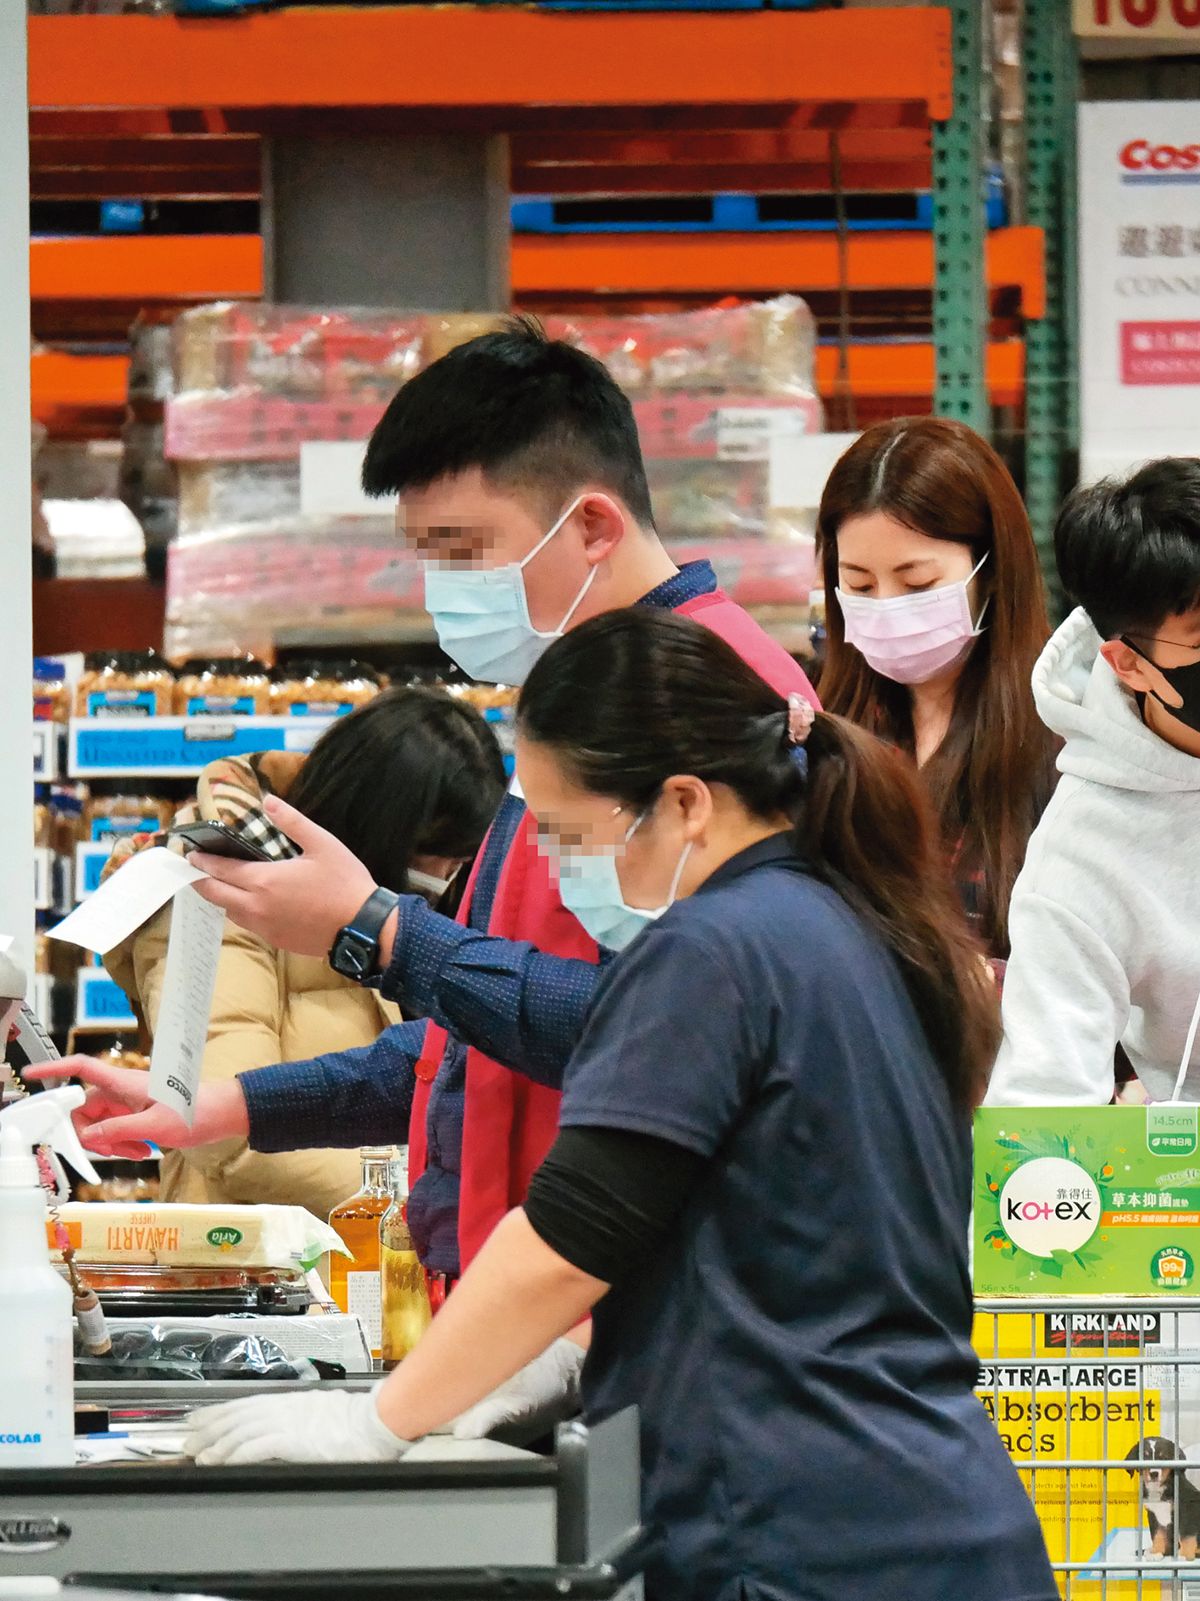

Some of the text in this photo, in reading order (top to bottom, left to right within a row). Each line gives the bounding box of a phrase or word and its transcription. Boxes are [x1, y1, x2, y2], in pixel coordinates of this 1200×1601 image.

[1057, 1188, 1093, 1200] 靠得住
[1007, 1197, 1092, 1221] kotex
[1112, 1214, 1140, 1224] pH5.5
[107, 1227, 179, 1251] HAVARTI
[211, 1230, 238, 1244] Arla
[1051, 1314, 1156, 1331] KRKLAND
